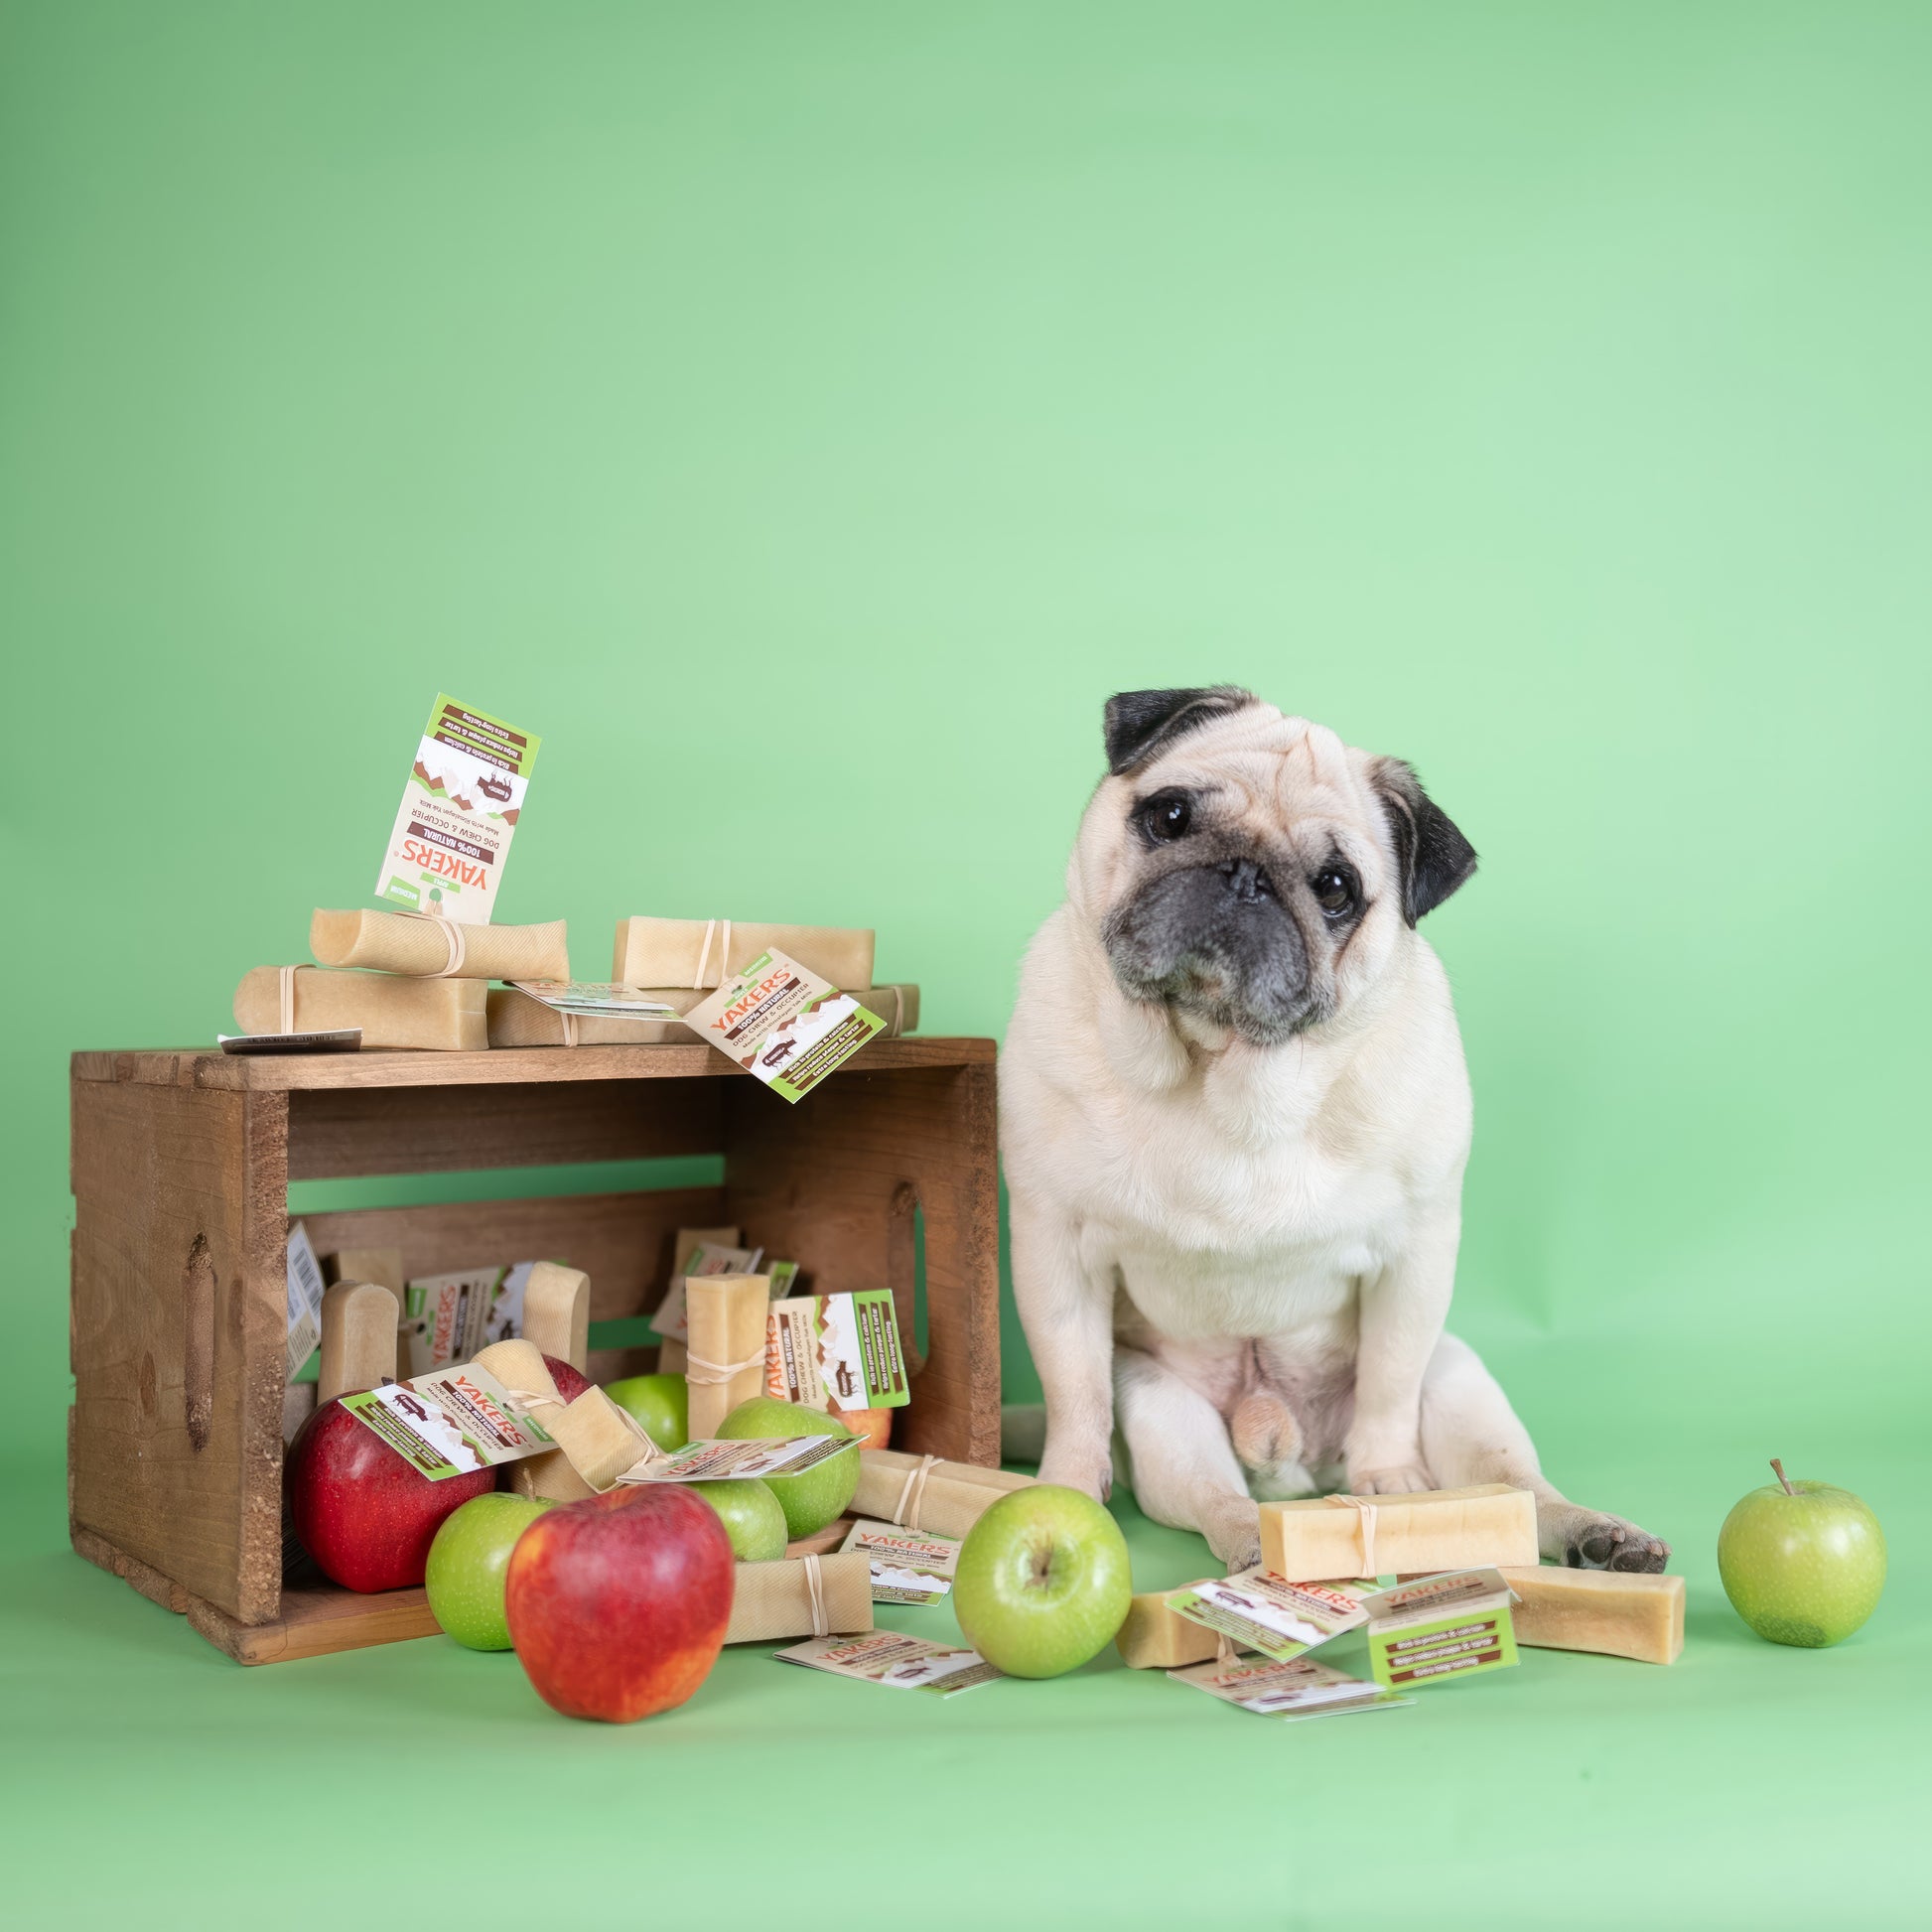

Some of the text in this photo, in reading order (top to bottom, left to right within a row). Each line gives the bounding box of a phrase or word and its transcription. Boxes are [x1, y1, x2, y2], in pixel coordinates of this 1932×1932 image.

[411, 808, 450, 828] OCCUPIER
[423, 829, 481, 858] 100% NATURAL
[460, 829, 482, 842] CHEW
[483, 838, 499, 850] DOG
[737, 988, 789, 1031] 100% NATURAL
[733, 1034, 749, 1046] DOG
